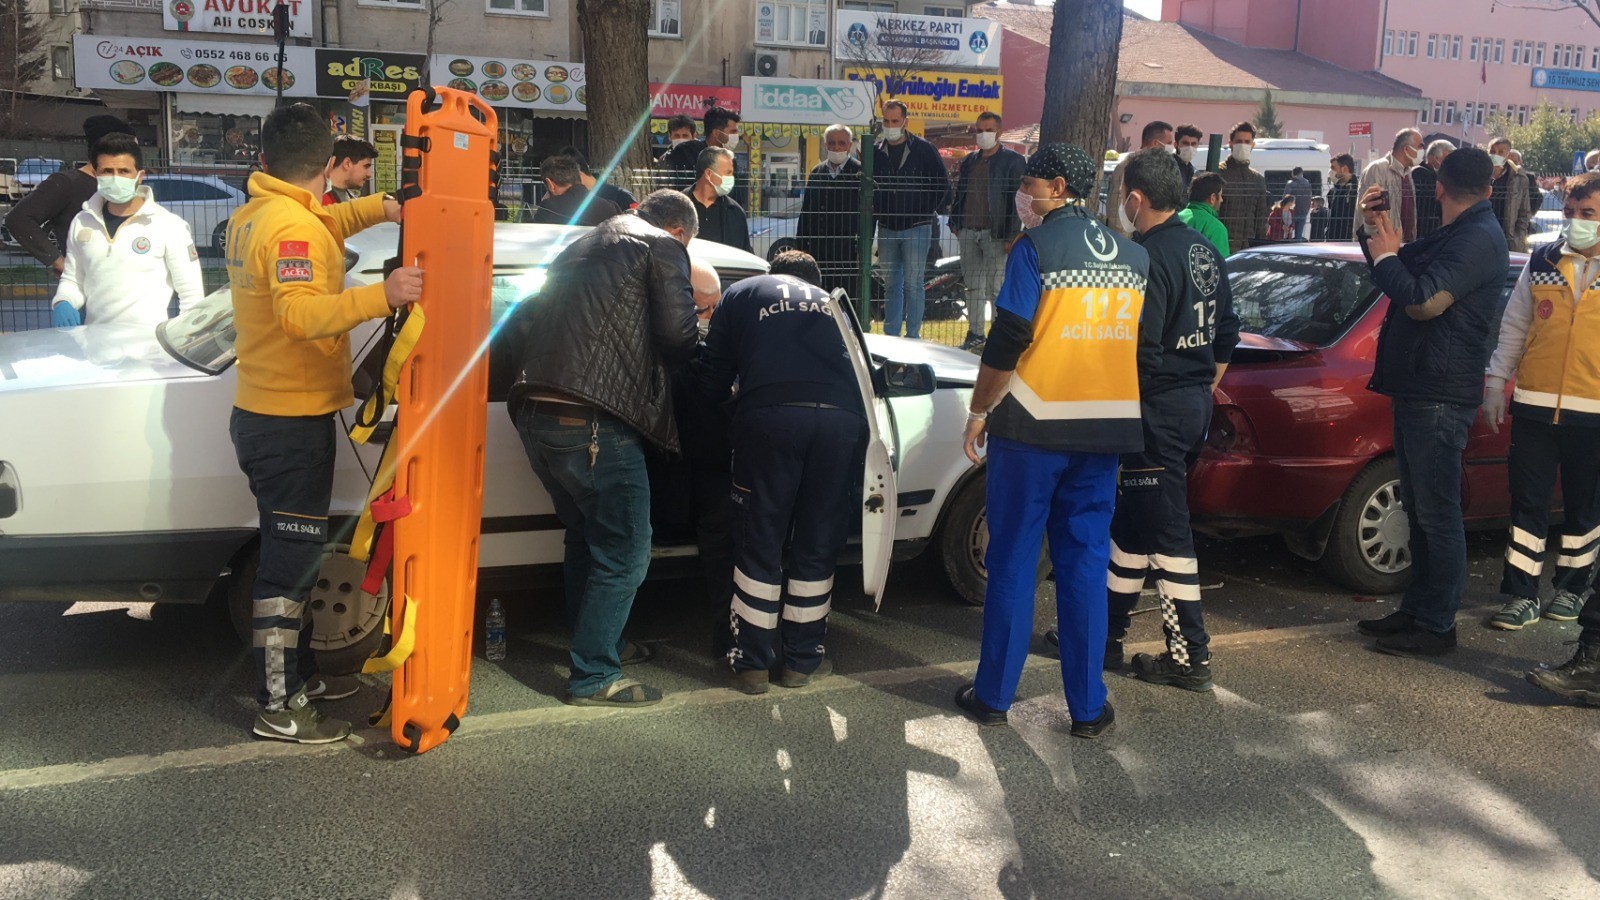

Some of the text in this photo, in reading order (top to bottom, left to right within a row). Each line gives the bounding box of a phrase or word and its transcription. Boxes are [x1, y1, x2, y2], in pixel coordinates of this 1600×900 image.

[213, 16, 232, 27] Ali
[876, 17, 963, 34] MERKEZ PARTİ
[125, 45, 163, 57] AÇIK
[195, 49, 225, 60] 0552
[229, 50, 251, 61] 468
[255, 52, 269, 61] 66
[327, 57, 419, 80] adRes
[349, 81, 401, 91] OKBAŞI
[958, 79, 1001, 99] Emlak
[650, 92, 704, 110] ANYAN
[758, 85, 823, 109] iddaa
[759, 299, 795, 321] ACİL
[1081, 290, 1132, 319] 112
[1193, 299, 1216, 328] 12
[1061, 320, 1134, 340] ACİL SAĞL
[1175, 329, 1208, 350] ACİL
[277, 522, 321, 534] 112 ACİL SAĞLIK
